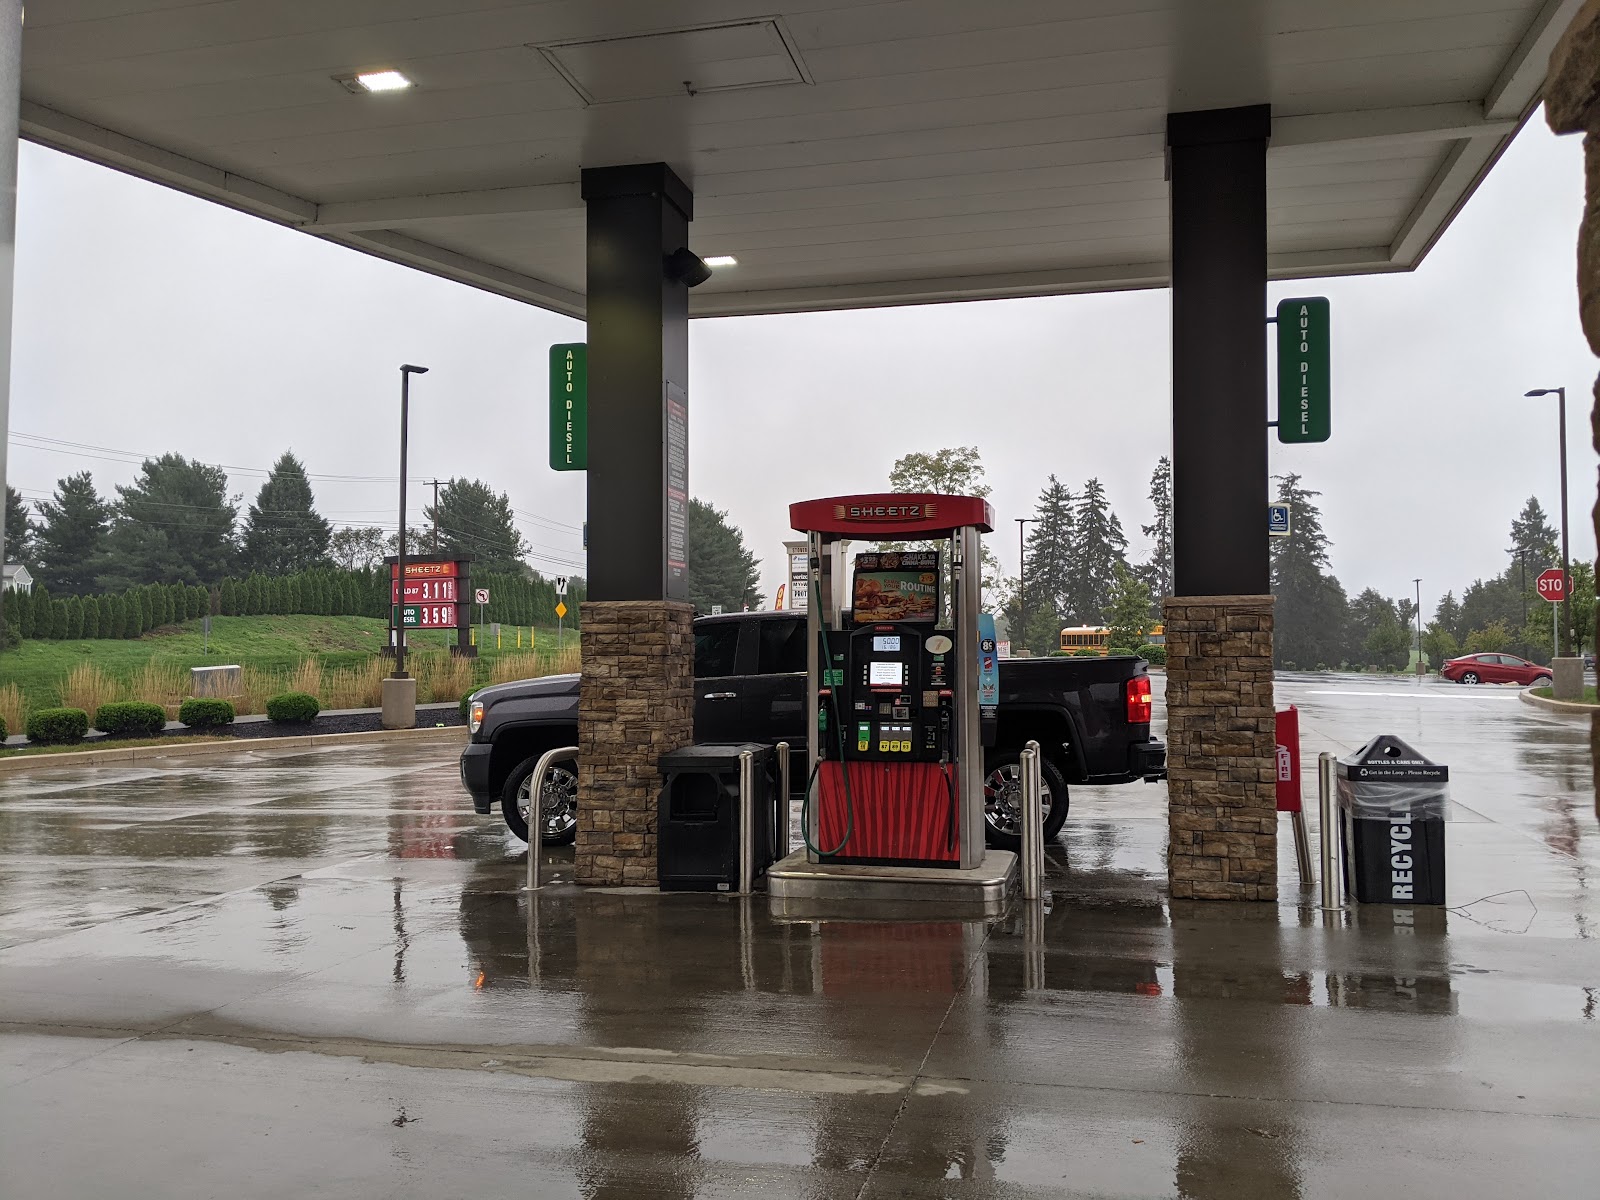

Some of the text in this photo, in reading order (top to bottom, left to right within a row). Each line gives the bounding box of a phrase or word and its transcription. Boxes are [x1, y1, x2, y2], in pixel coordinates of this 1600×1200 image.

[1300, 305, 1309, 434] AUTO DIESEL
[850, 505, 920, 517] SHEETZ
[405, 566, 441, 574] SHEETZ
[422, 582, 447, 599] 3.11
[900, 580, 936, 593] ROUTINE
[1540, 579, 1563, 591] STO
[422, 606, 448, 624] 3.59
[934, 638, 944, 651] 7
[1280, 753, 1289, 779] FIRE
